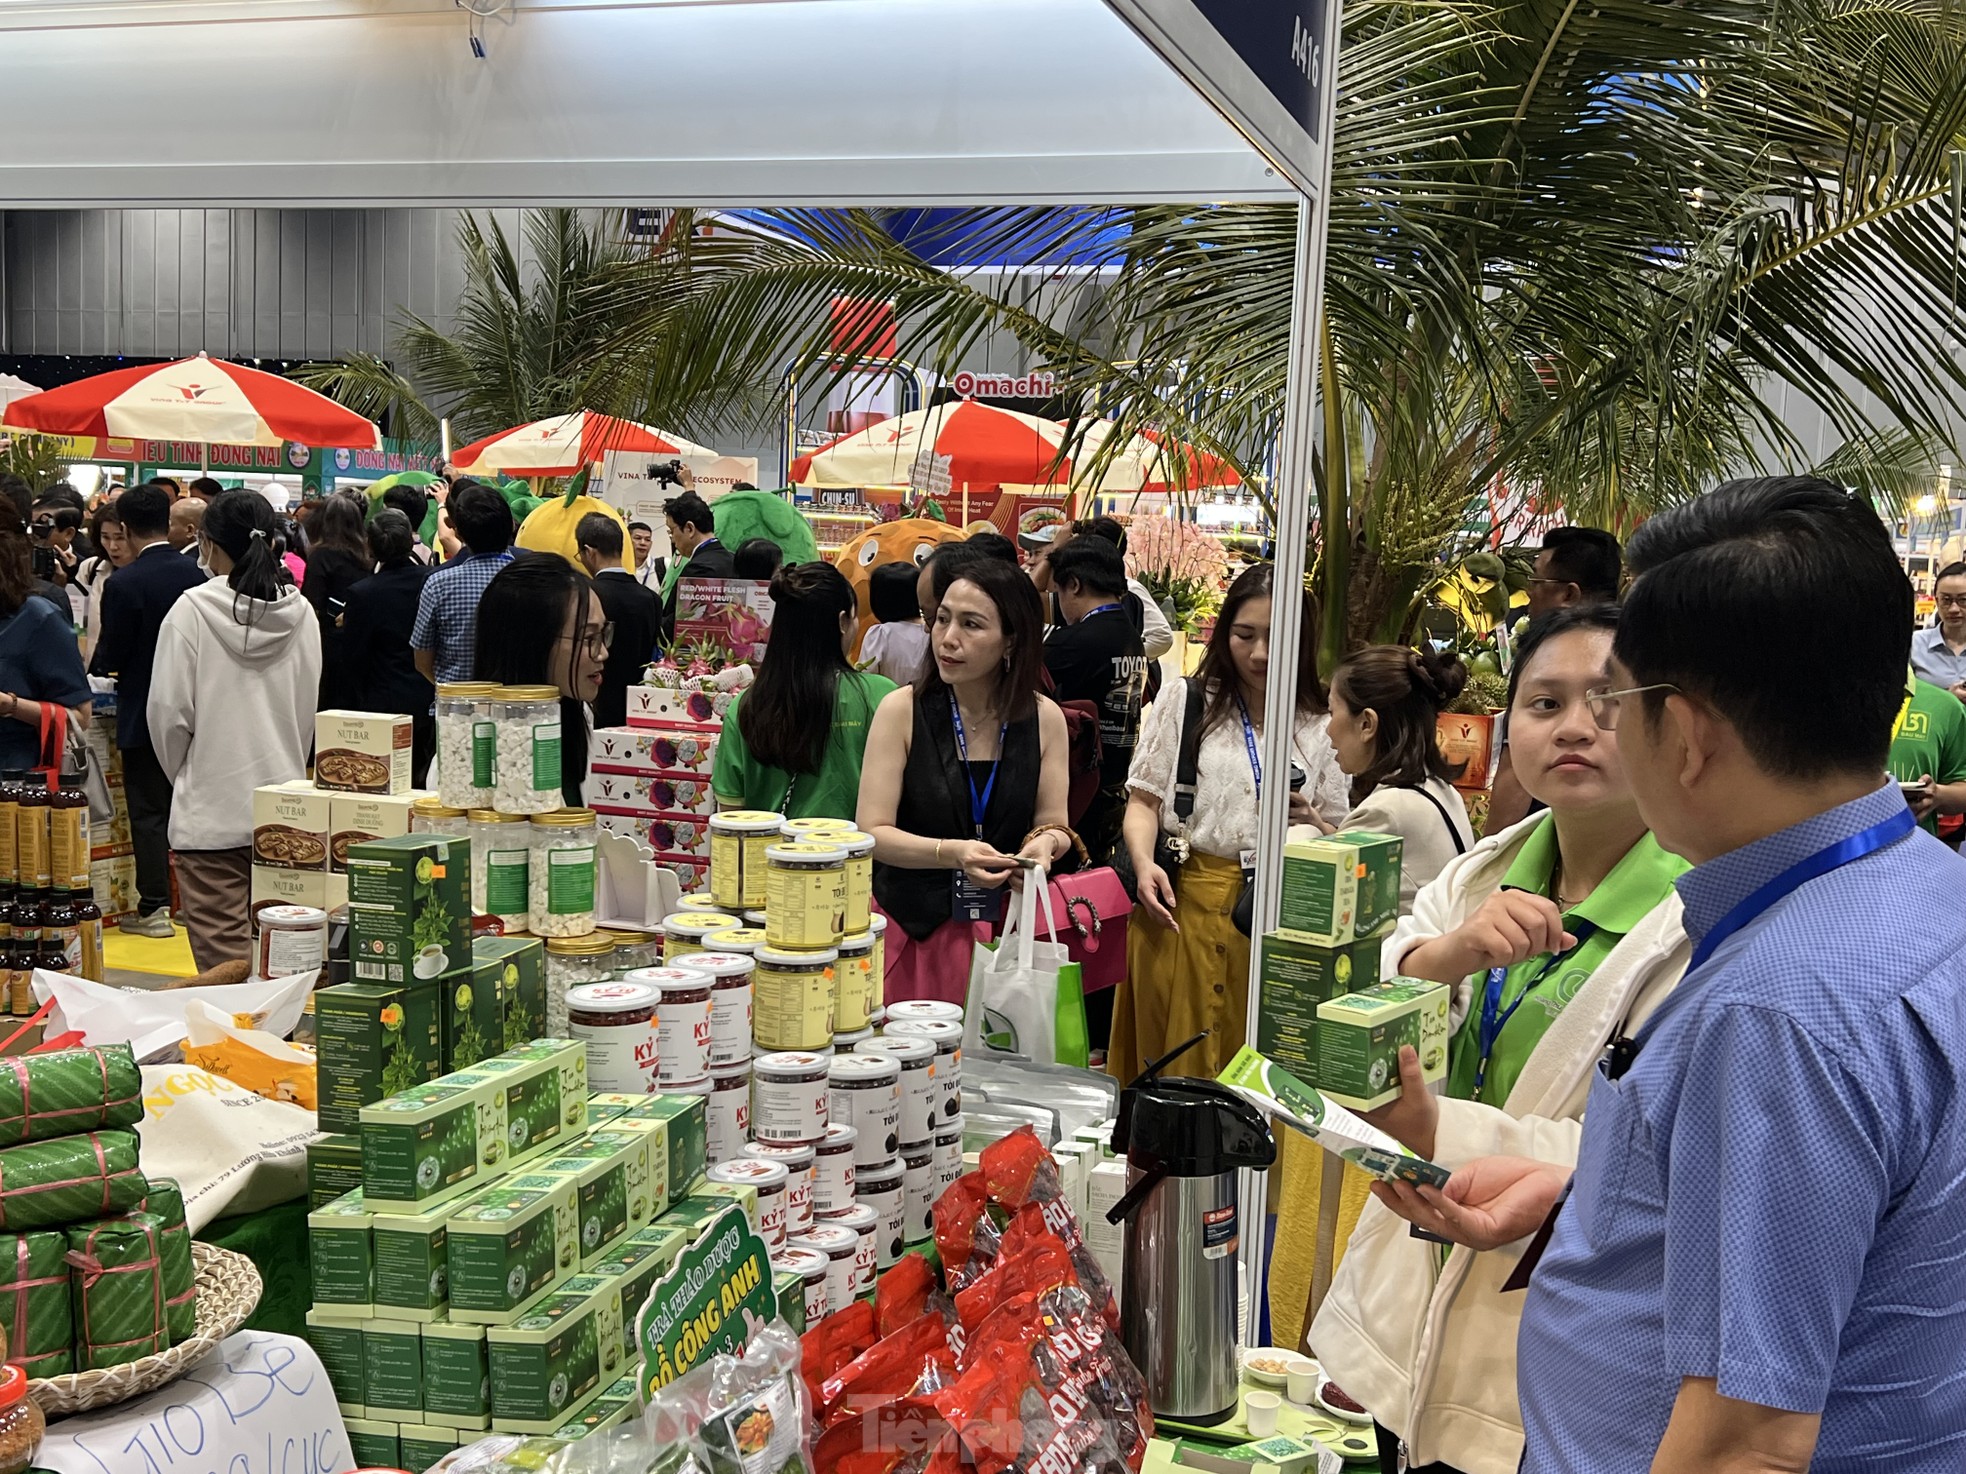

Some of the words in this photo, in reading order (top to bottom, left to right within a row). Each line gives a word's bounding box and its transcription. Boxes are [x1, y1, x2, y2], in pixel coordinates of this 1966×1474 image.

[1290, 14, 1320, 88] A416
[954, 373, 1055, 396] Omachi
[693, 476, 742, 485] ECOSYSTEM
[821, 491, 855, 506] CHIN-SU
[680, 584, 721, 593] RED/WHITE
[723, 586, 746, 594] FLESH
[712, 595, 734, 603] FRUIT
[337, 729, 353, 739] NUT
[354, 730, 370, 740] BAR
[275, 805, 290, 816] NUT
[291, 806, 307, 817] BAR
[273, 881, 289, 892] NUT
[289, 882, 305, 893] BAR
[144, 1072, 234, 1122] NGỌC
[702, 1225, 741, 1282] DƯỢC
[672, 1317, 721, 1375] CÔNG
[718, 1253, 761, 1320] ANH
